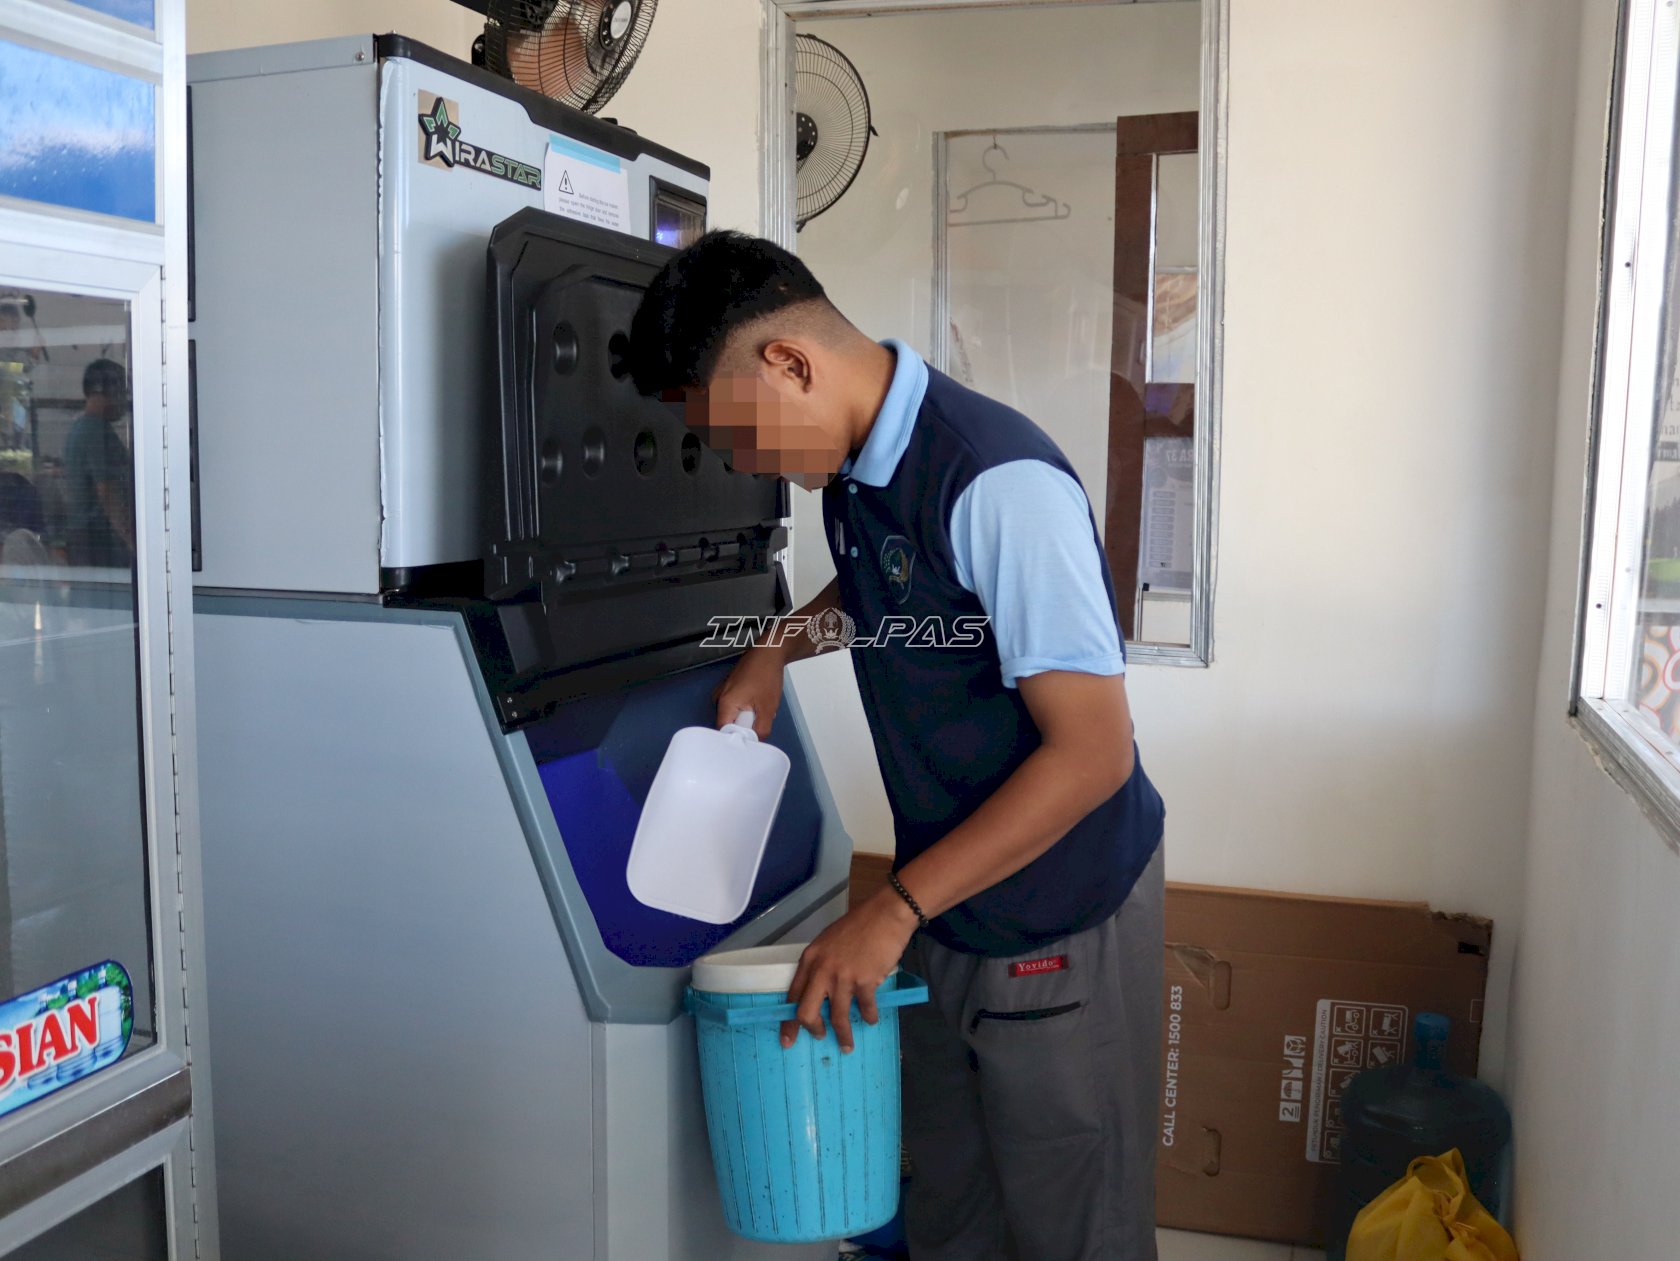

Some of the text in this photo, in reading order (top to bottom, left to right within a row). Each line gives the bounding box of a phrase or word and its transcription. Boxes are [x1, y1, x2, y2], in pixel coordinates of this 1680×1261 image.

[1162, 985, 1183, 1147] CALL CENTER: 1500 833
[1282, 1107, 1294, 1118] 2
